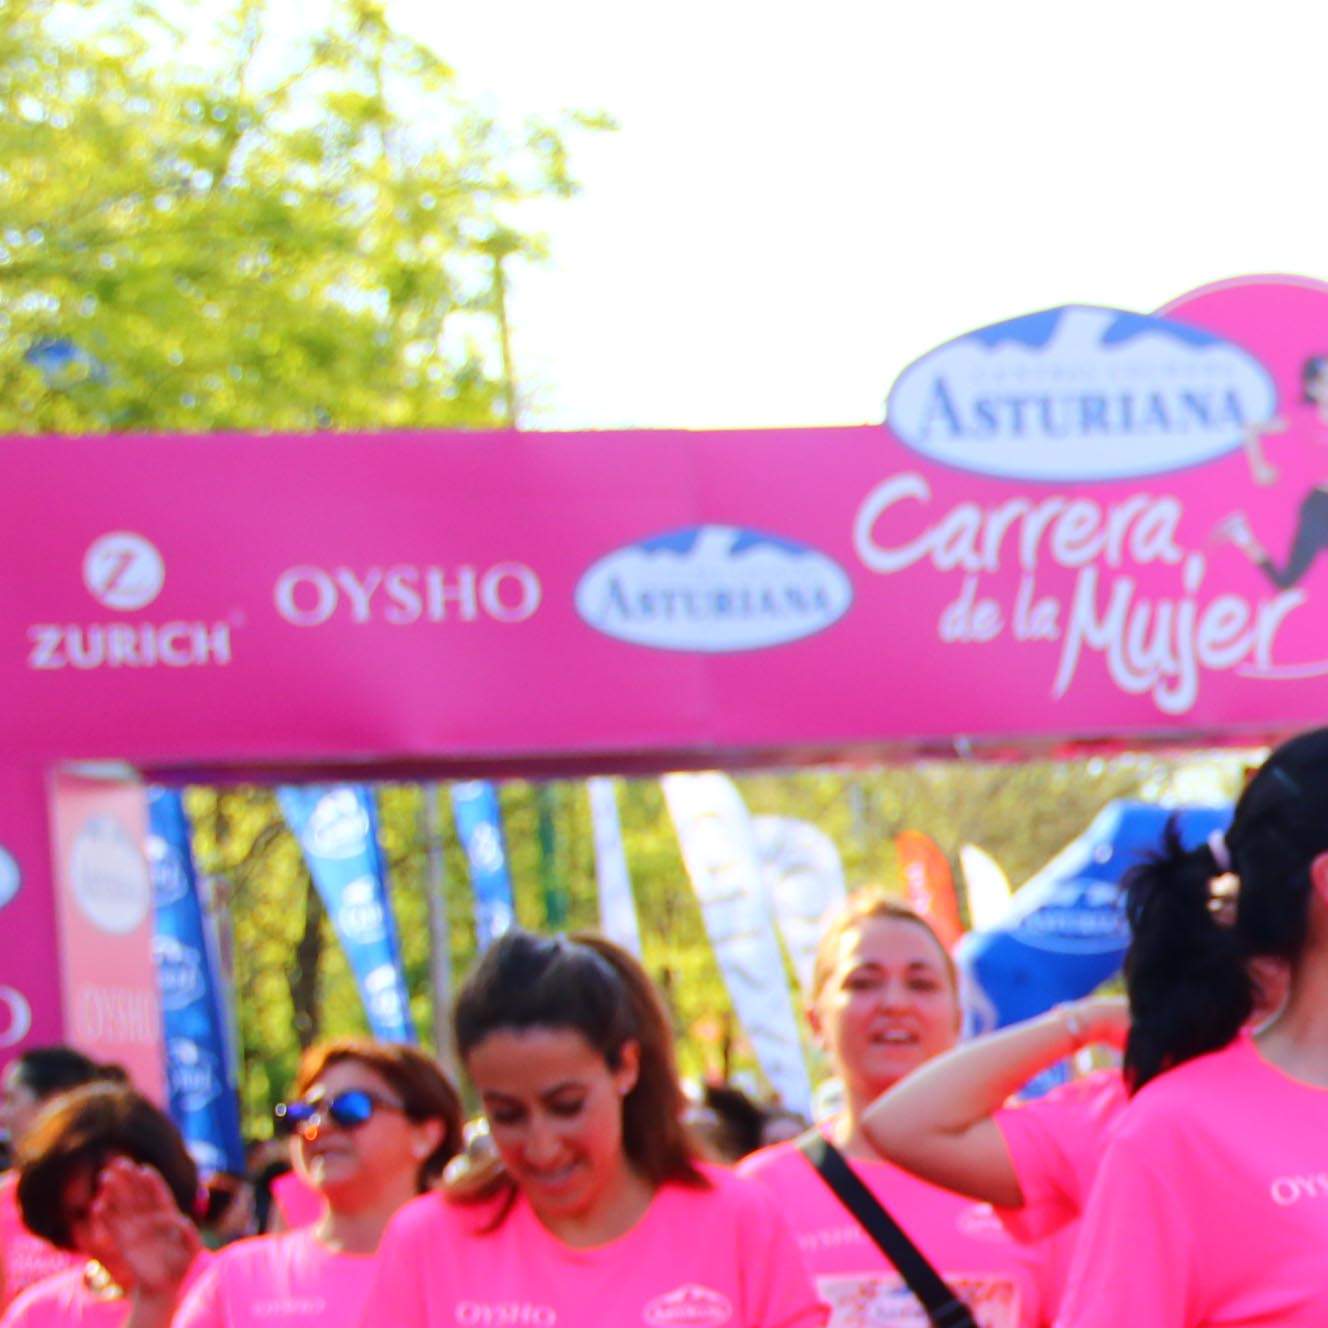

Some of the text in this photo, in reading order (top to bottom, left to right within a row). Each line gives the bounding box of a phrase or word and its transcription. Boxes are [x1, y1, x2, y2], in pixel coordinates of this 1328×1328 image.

[917, 374, 1246, 444] ASTURIANA
[853, 472, 1184, 575] Carrera
[273, 562, 543, 627] OYSHO
[603, 570, 831, 619] ASTURIANA
[27, 619, 233, 670] ZURICH
[939, 553, 1306, 716] de la Mujer
